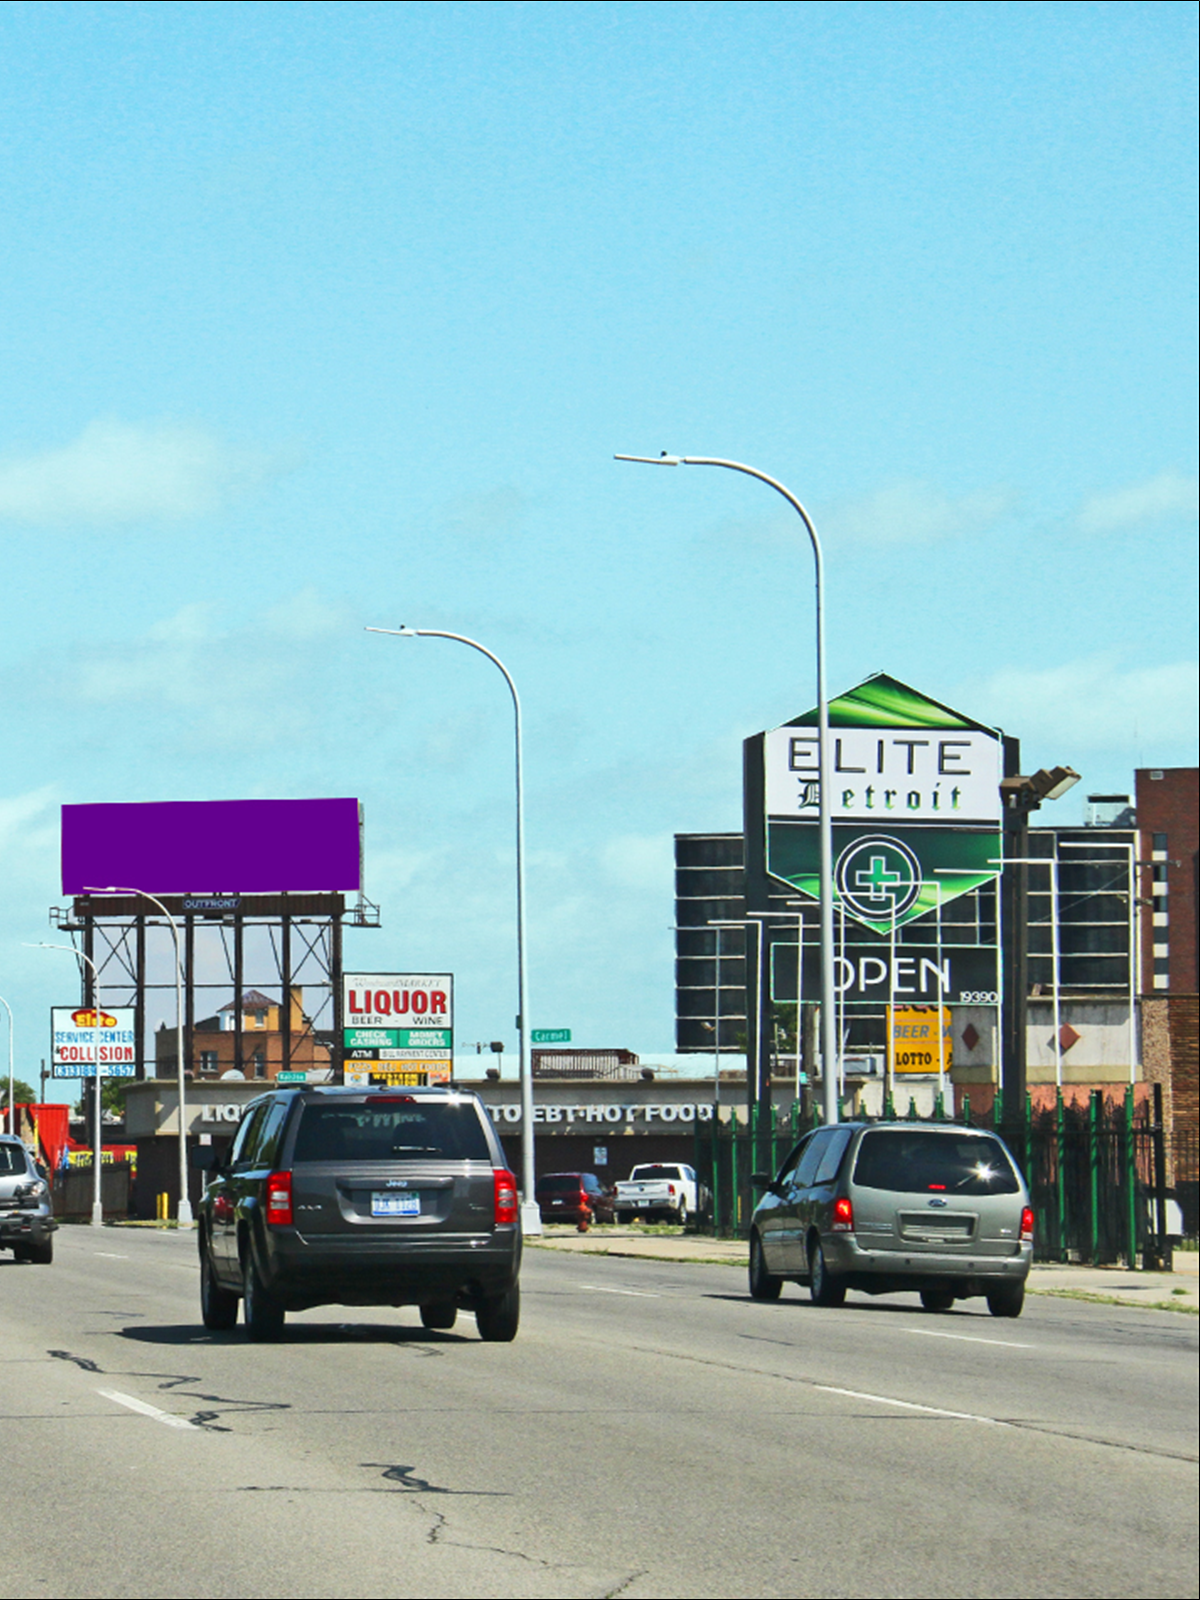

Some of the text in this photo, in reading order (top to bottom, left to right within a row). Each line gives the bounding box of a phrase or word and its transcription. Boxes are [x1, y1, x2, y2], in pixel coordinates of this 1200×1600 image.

[789, 736, 972, 776] ELITE
[798, 776, 962, 811] Detroit
[185, 899, 237, 908] OUTFRONT
[831, 956, 951, 994] OPEN
[349, 990, 447, 1015] LIQUOR
[960, 991, 999, 1003] 19390
[351, 1016, 443, 1025] BEER WINE
[54, 1030, 135, 1044] SERVICE CENTER
[355, 1030, 388, 1038] CHECK
[535, 1030, 568, 1041] Carmel
[893, 1024, 930, 1039] BEER
[350, 1038, 393, 1046] CASHING
[408, 1038, 446, 1046] ORDERS
[60, 1046, 133, 1061] COLLISION
[351, 1050, 373, 1058] ATM
[895, 1052, 932, 1065] LOTTO
[401, 1062, 418, 1071] HOT
[420, 1062, 448, 1071] FOODS
[201, 1104, 246, 1122] LIQ
